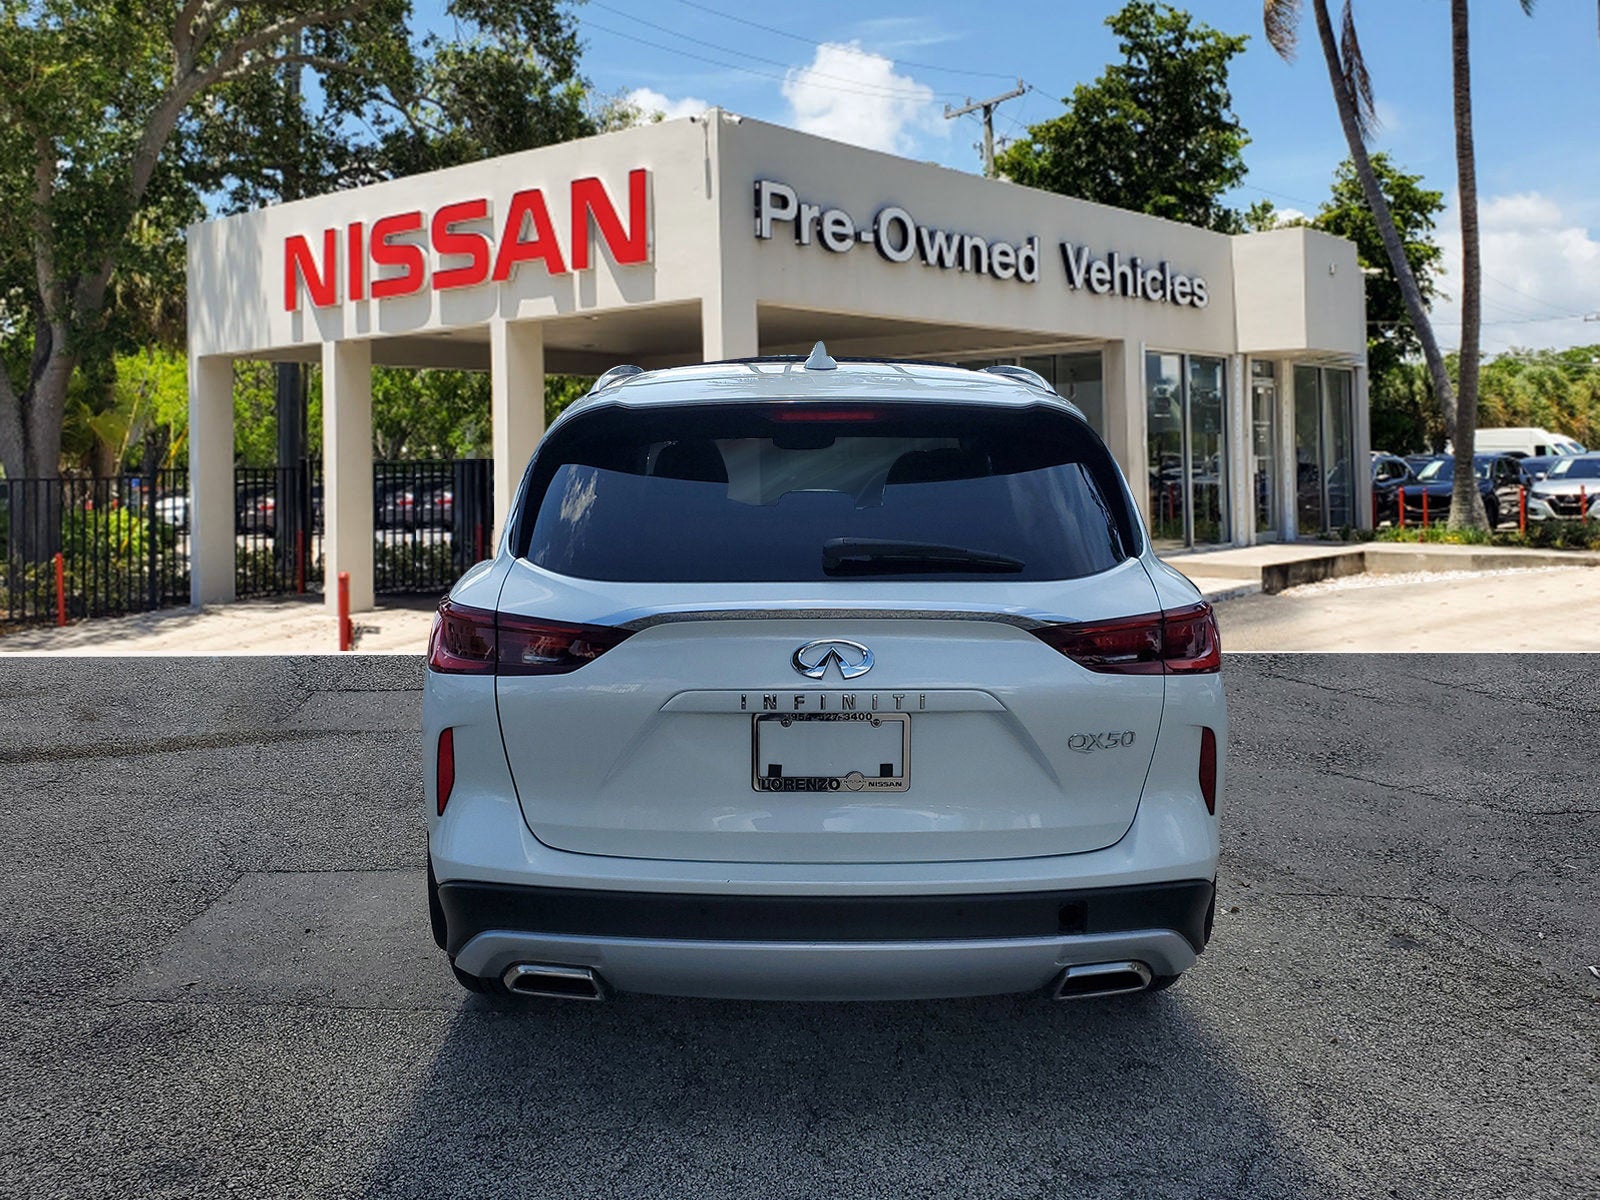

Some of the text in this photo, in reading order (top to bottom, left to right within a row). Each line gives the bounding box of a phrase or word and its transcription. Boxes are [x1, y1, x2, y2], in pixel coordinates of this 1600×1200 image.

[285, 168, 648, 312] NISSAN
[754, 180, 1209, 309] Pre-Owned Vehicles
[740, 693, 926, 711] INFINITI
[1067, 730, 1137, 754] QX50
[760, 778, 841, 791] LORENZO
